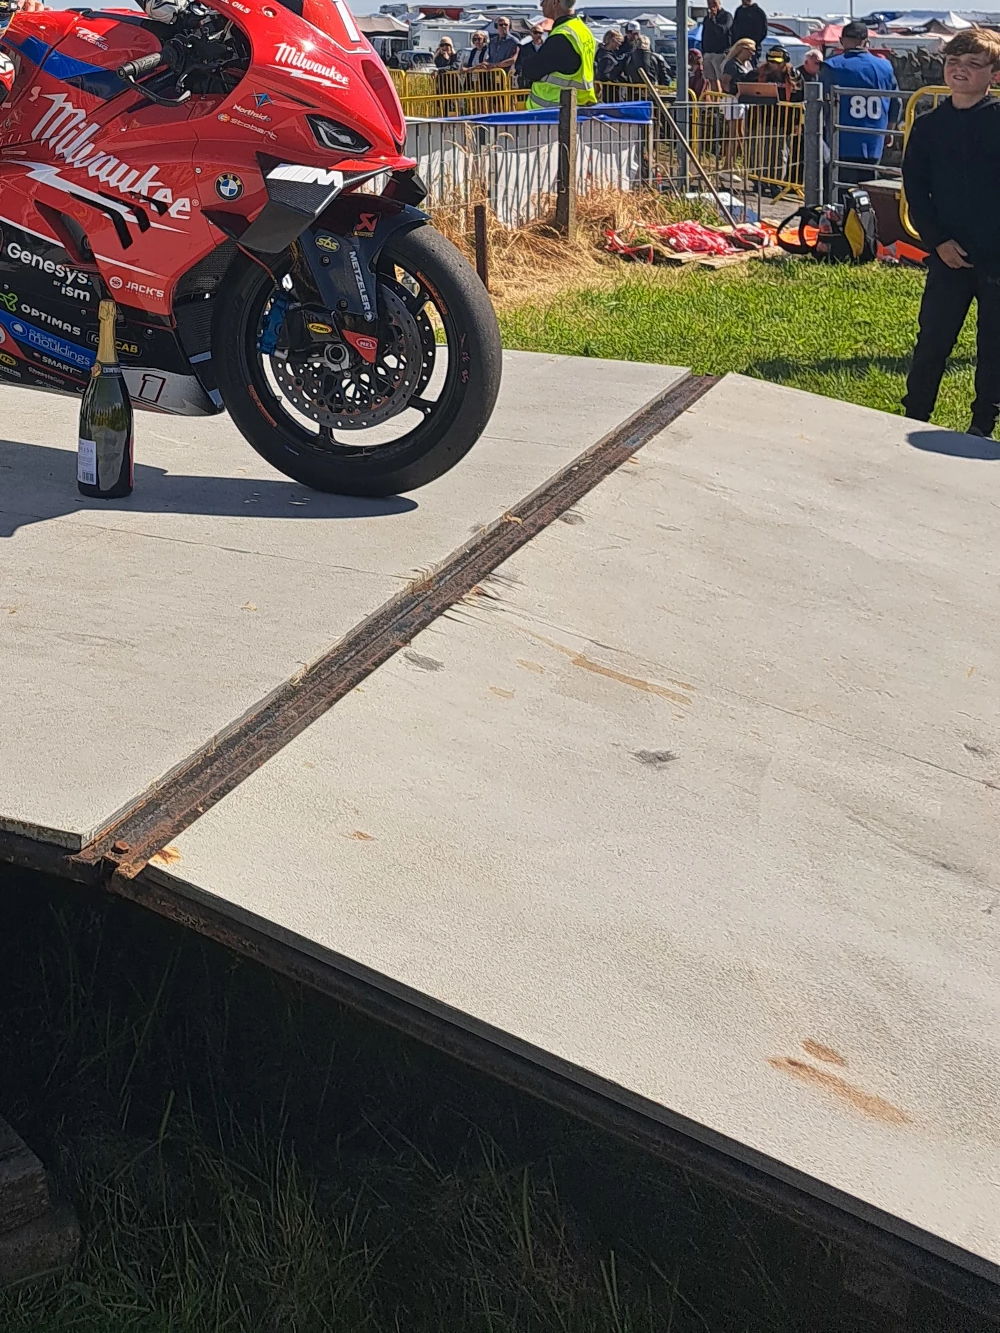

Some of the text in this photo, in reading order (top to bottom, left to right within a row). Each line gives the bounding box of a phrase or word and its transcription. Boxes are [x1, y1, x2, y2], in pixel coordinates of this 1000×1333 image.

[231, 1, 251, 14] OILS
[76, 34, 109, 50] RACING
[274, 42, 349, 85] Milwaukee
[233, 104, 271, 121] Northside
[850, 96, 882, 120] 80
[31, 93, 191, 219] Milwaukee
[125, 281, 165, 298] JACK'S
[349, 250, 371, 311] METZELER
[61, 284, 90, 302] ism
[21, 304, 81, 336] OPTIMAS
[28, 334, 91, 366] mouldings
[42, 356, 74, 374] SMART
